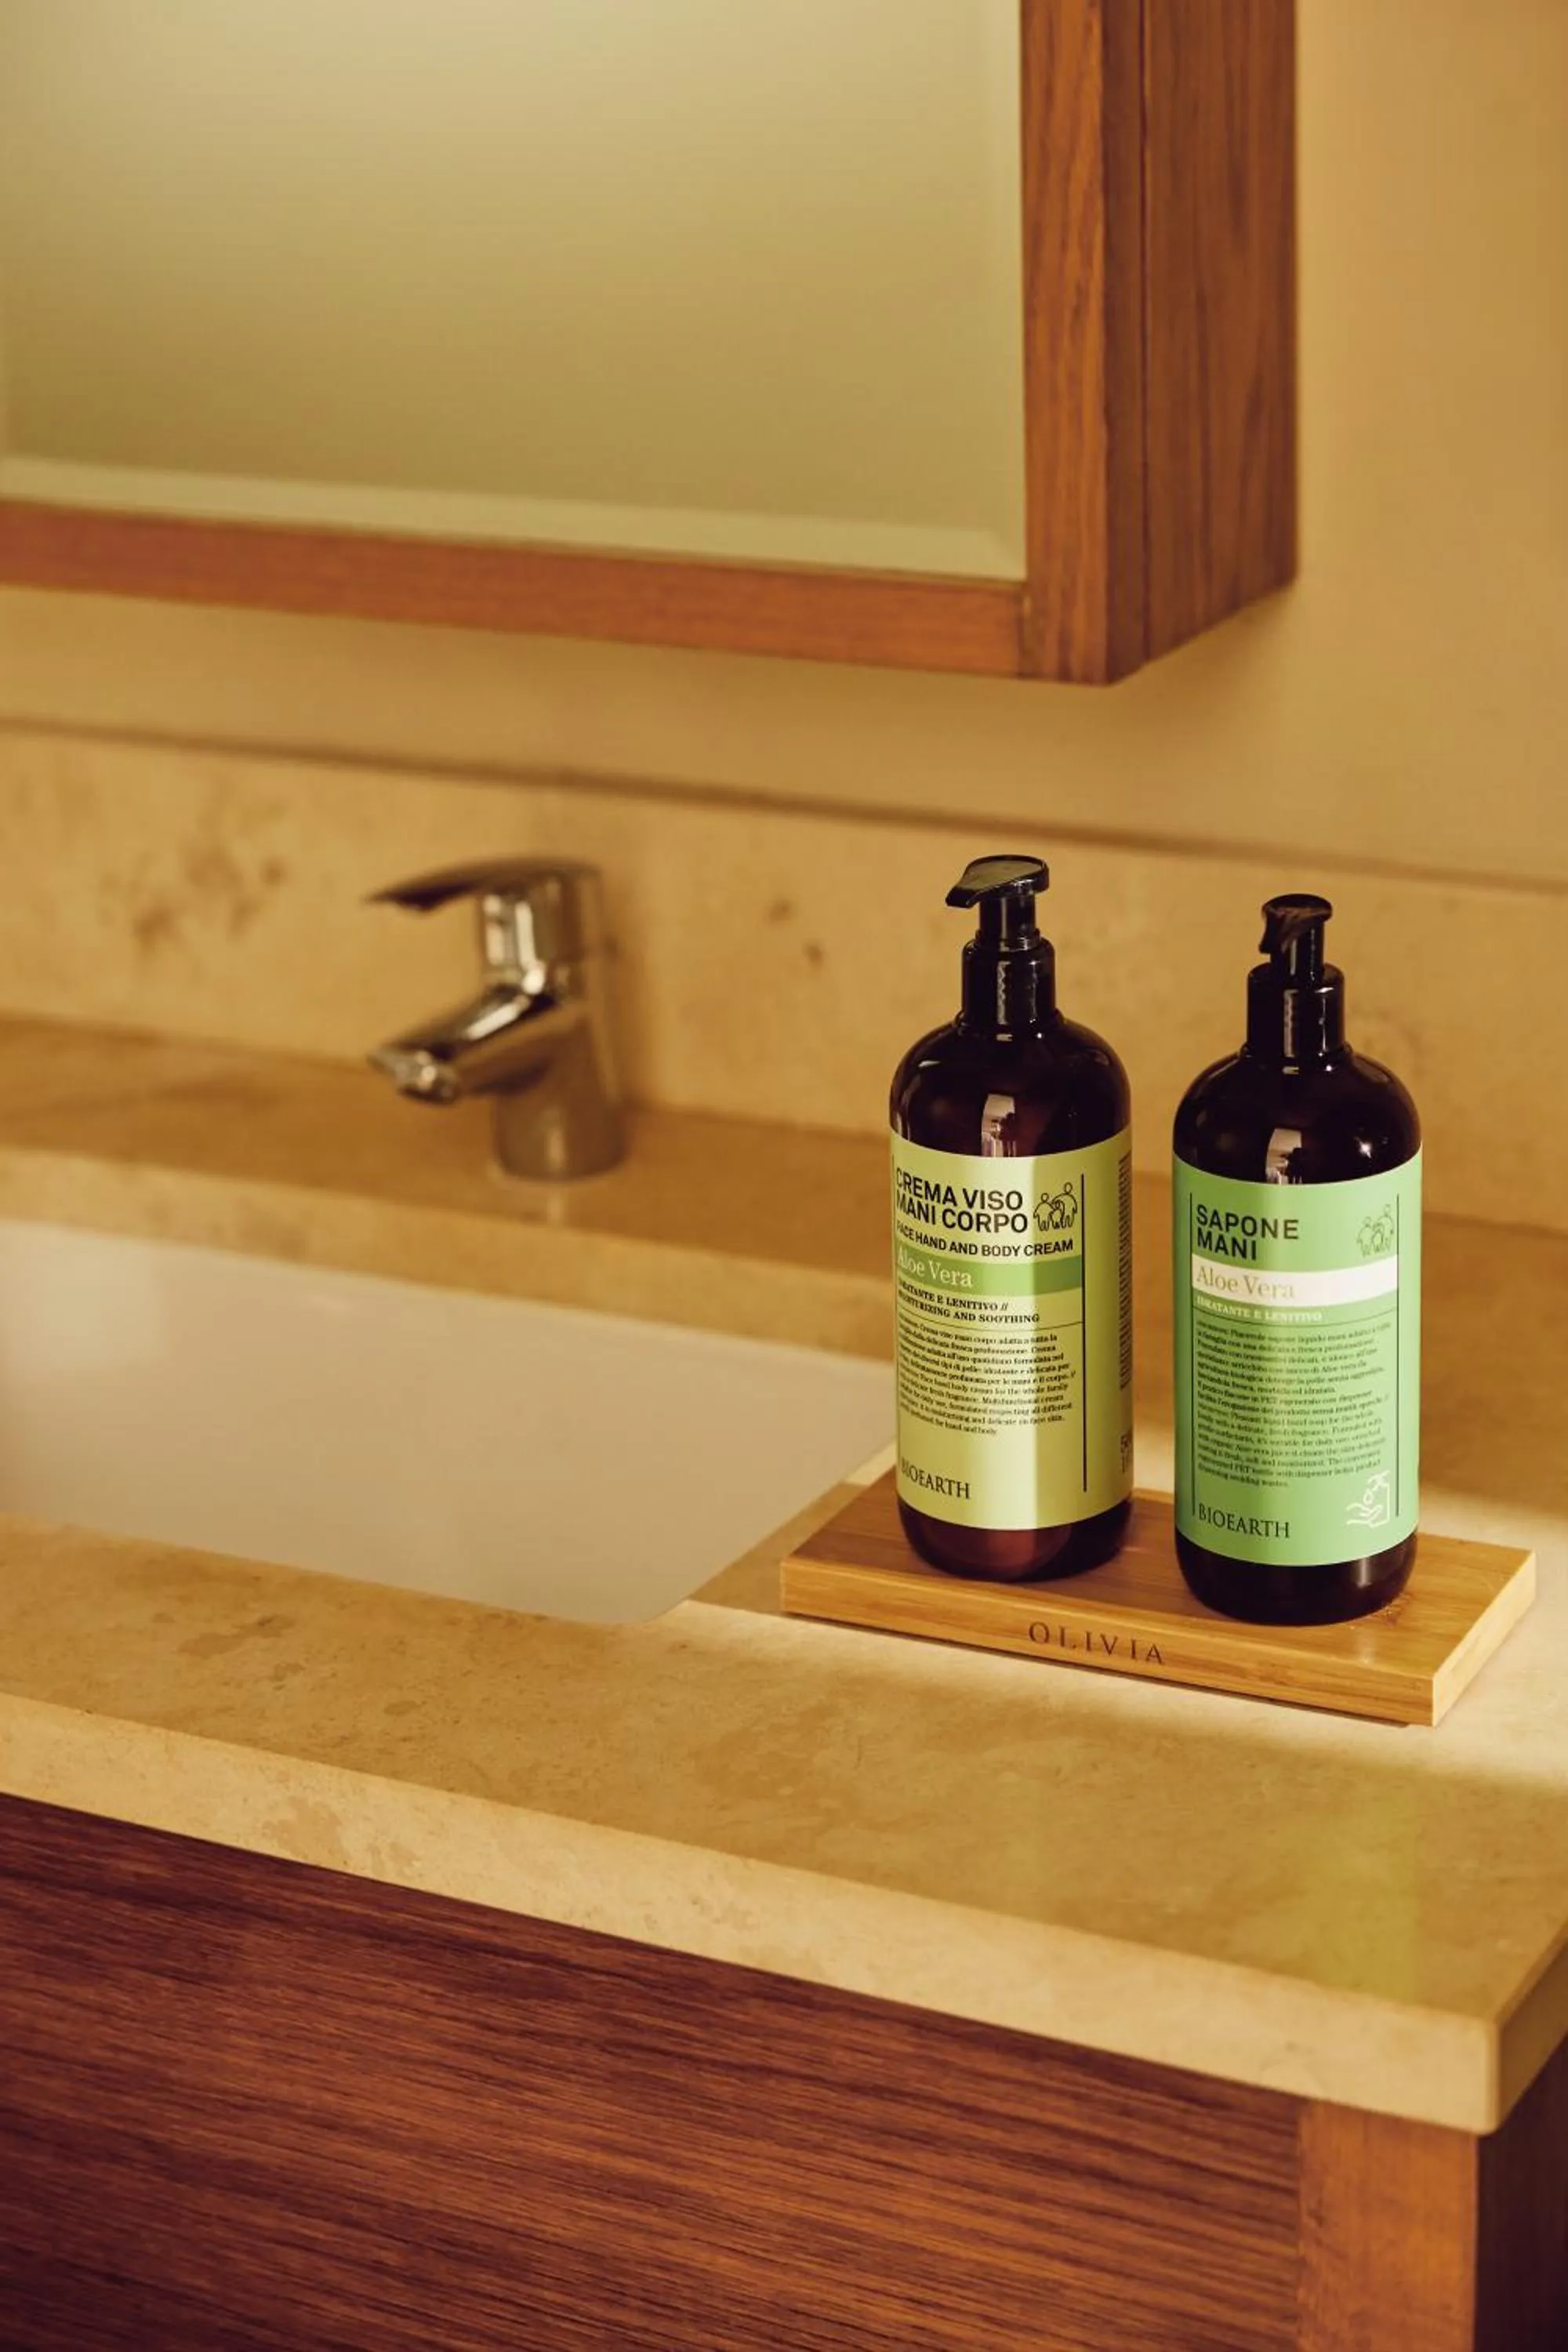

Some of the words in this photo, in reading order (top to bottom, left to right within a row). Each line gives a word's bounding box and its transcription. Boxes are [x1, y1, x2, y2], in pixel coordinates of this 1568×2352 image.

[896, 1167, 957, 1207] CREMA
[962, 1188, 1022, 1210] VISO
[896, 1189, 935, 1225] MANI
[942, 1208, 1028, 1233] CORPO
[1196, 1203, 1299, 1240] SAPONE
[915, 1231, 946, 1250] HAND
[949, 1241, 978, 1255] AND
[982, 1244, 1020, 1257] BODY
[1024, 1238, 1073, 1256] CREAM
[1196, 1227, 1257, 1261] MANI
[928, 1260, 972, 1288] Vera
[1196, 1265, 1238, 1292] Aloe
[1244, 1275, 1294, 1299] Vera
[937, 1294, 944, 1304] E
[946, 1298, 997, 1311] LENITIVO
[953, 1312, 976, 1322] AND
[979, 1313, 1040, 1324] SOOTHING
[902, 1456, 970, 1500] BIOEARTH
[1198, 1503, 1290, 1538] BIOEARTH
[1029, 1621, 1166, 1665] OLIVIA
